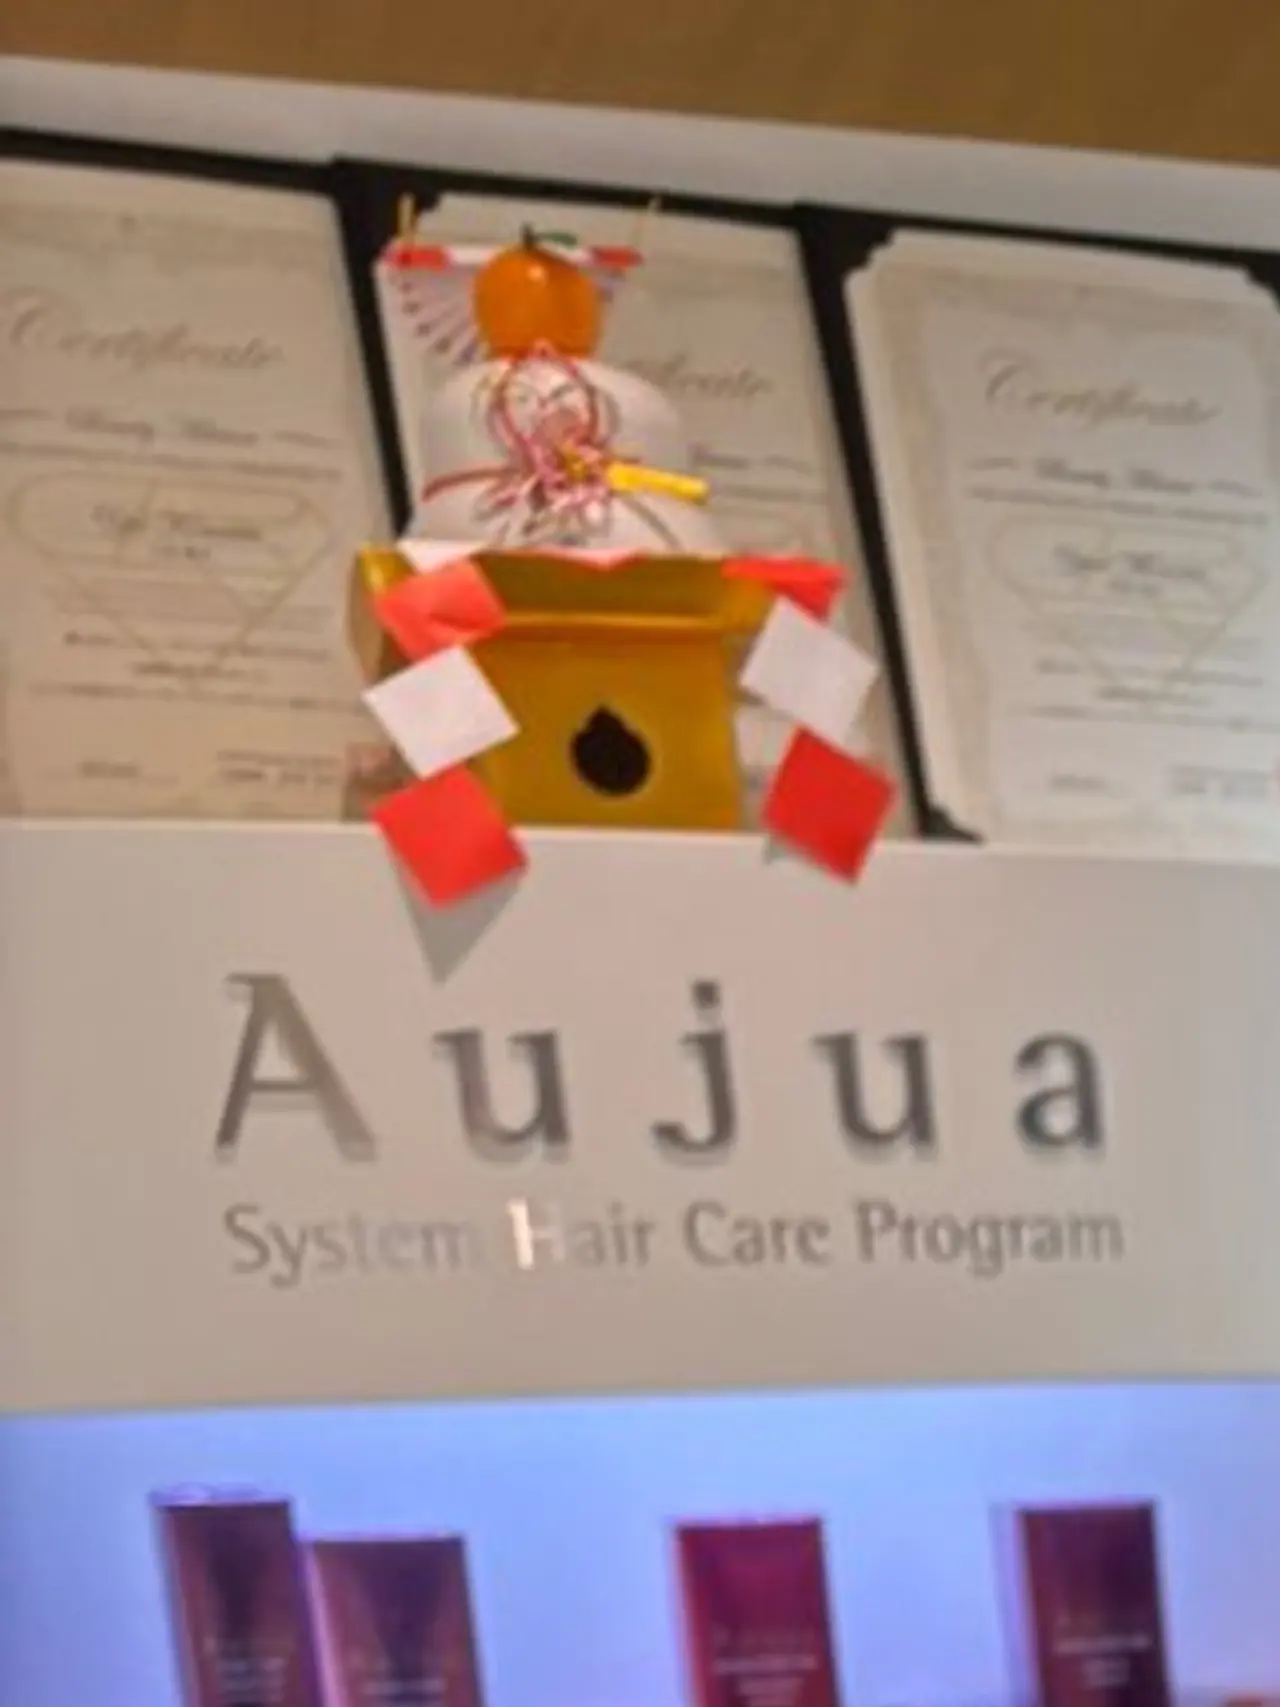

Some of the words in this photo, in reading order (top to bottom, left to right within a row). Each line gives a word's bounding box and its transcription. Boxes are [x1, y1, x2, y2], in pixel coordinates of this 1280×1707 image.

[213, 970, 1108, 1164] Aujua
[223, 1202, 482, 1288] System
[508, 1197, 656, 1271] Hair
[682, 1200, 832, 1268] Care
[856, 1198, 1125, 1280] Program
